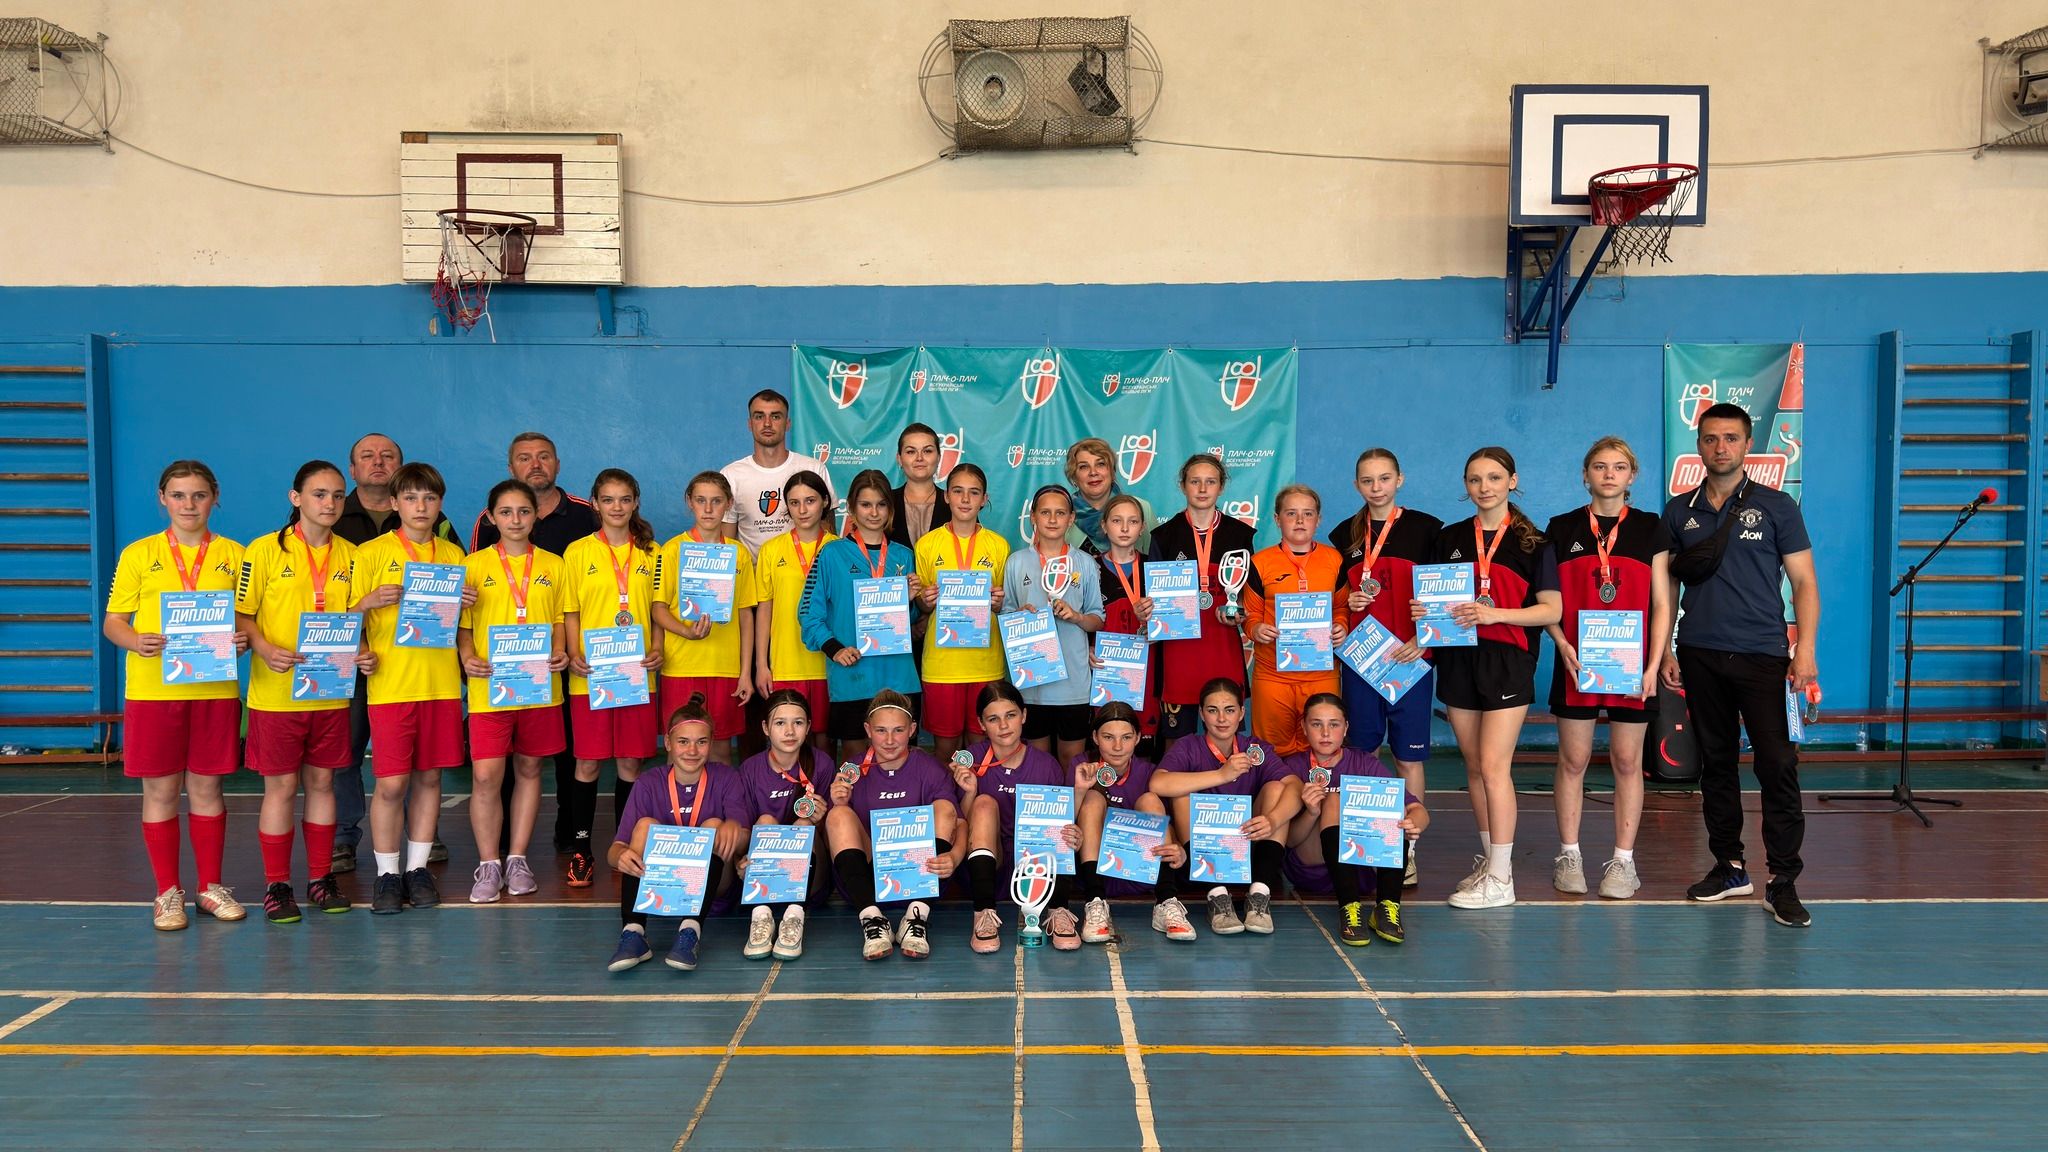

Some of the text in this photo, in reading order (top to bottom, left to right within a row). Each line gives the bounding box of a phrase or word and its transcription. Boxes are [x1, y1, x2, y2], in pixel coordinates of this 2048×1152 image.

[1728, 387, 1754, 396] ПЛІЧ
[685, 557, 729, 570] ДИПЛОМ
[408, 579, 457, 592] ДИПЛОМ
[1151, 576, 1191, 589] ДИПЛОМ
[1420, 579, 1466, 593] ДИПЛОМ
[942, 585, 984, 596] ДИПЛОМ
[860, 592, 901, 605] ДИПЛОМ
[169, 608, 225, 623] ДИПЛОМ
[1281, 607, 1325, 621] ДИПЛОМ
[304, 629, 354, 642] ДИПЛОМ
[1008, 619, 1047, 640] ДИПЛОМ
[1585, 626, 1635, 638] ДИПЛОМ
[495, 639, 543, 653] ДИПЛОМ
[592, 641, 636, 656] ДИПЛОМ
[1351, 630, 1383, 665] ДИПЛОМ
[1100, 646, 1141, 660] ДИПЛОМ
[878, 791, 906, 799] Zeus
[1346, 792, 1397, 808] ДИПЛОМ
[1022, 801, 1067, 815] ДИПЛОМ
[1112, 816, 1160, 829] ДИПЛОМ
[1196, 811, 1243, 824] ДИПЛОМ
[879, 823, 927, 840] ДИПЛОМ
[651, 841, 704, 856] ДИПЛОМ
[755, 839, 805, 850] ДИПЛОМ
